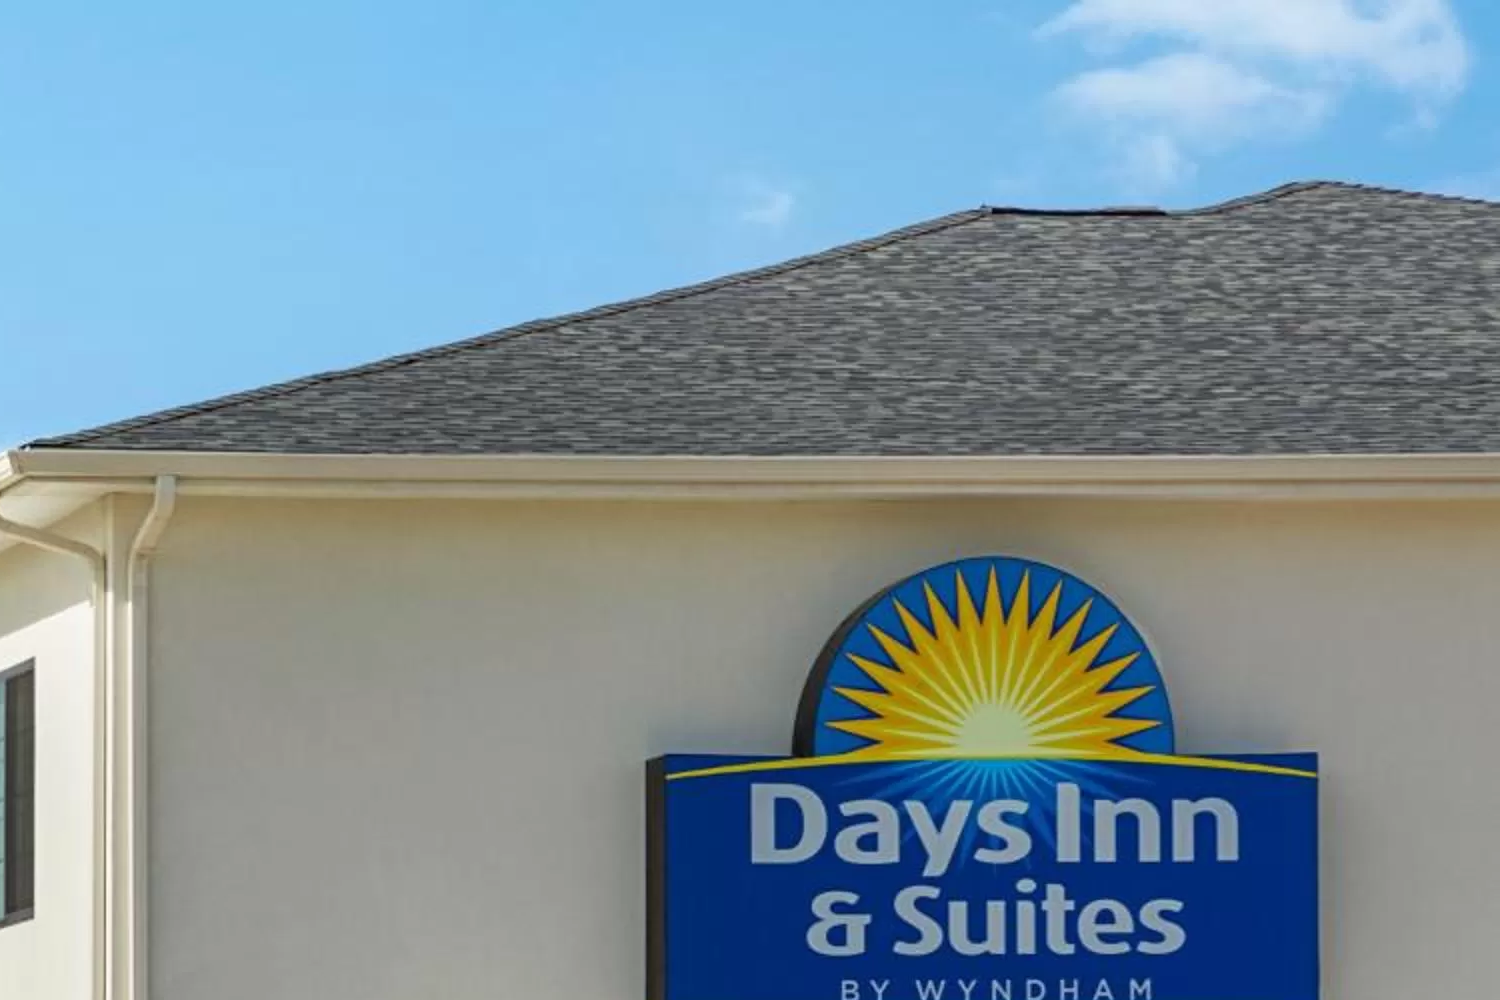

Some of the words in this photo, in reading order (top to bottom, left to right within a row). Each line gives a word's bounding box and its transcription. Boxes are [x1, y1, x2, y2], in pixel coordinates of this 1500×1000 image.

[750, 782, 1032, 877] Days
[1056, 782, 1239, 862] Inn
[806, 891, 871, 955] &
[893, 879, 1186, 955] Suites
